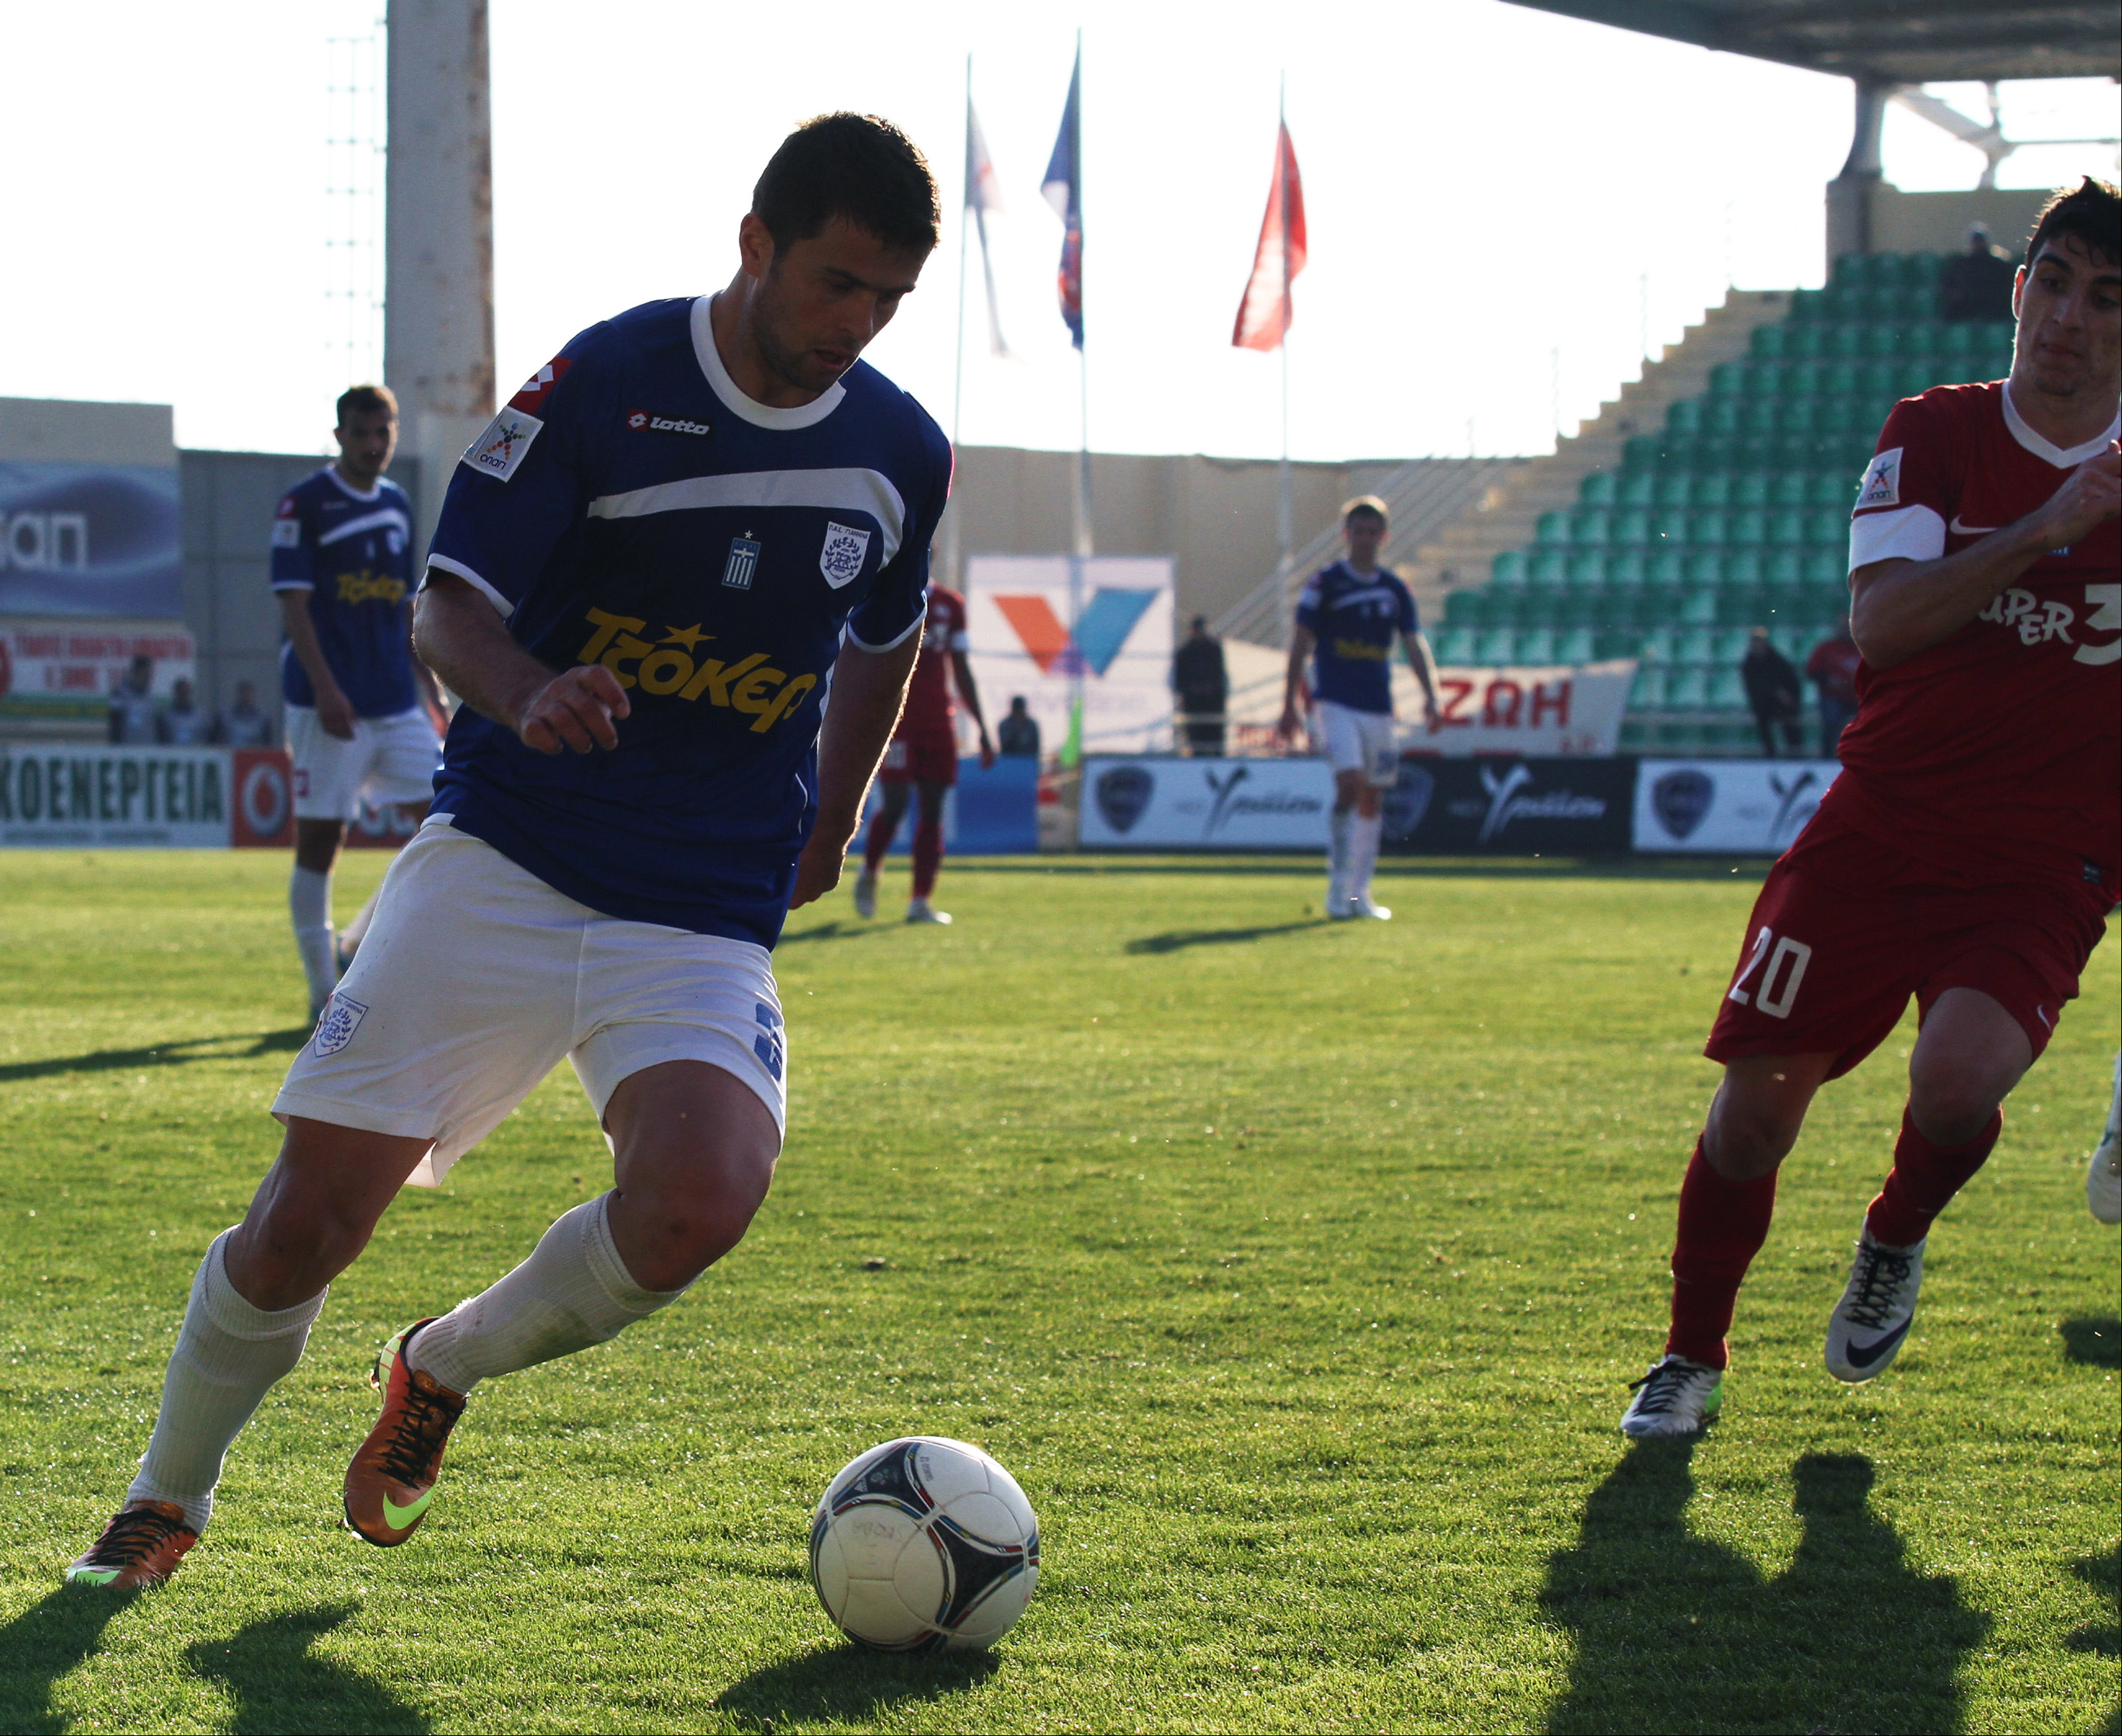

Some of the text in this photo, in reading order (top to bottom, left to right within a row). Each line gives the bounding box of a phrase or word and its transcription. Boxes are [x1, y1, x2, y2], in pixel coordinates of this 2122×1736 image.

[0, 511, 88, 572] an
[1979, 584, 2121, 666] UPER 3
[1728, 926, 1812, 1019] 20
